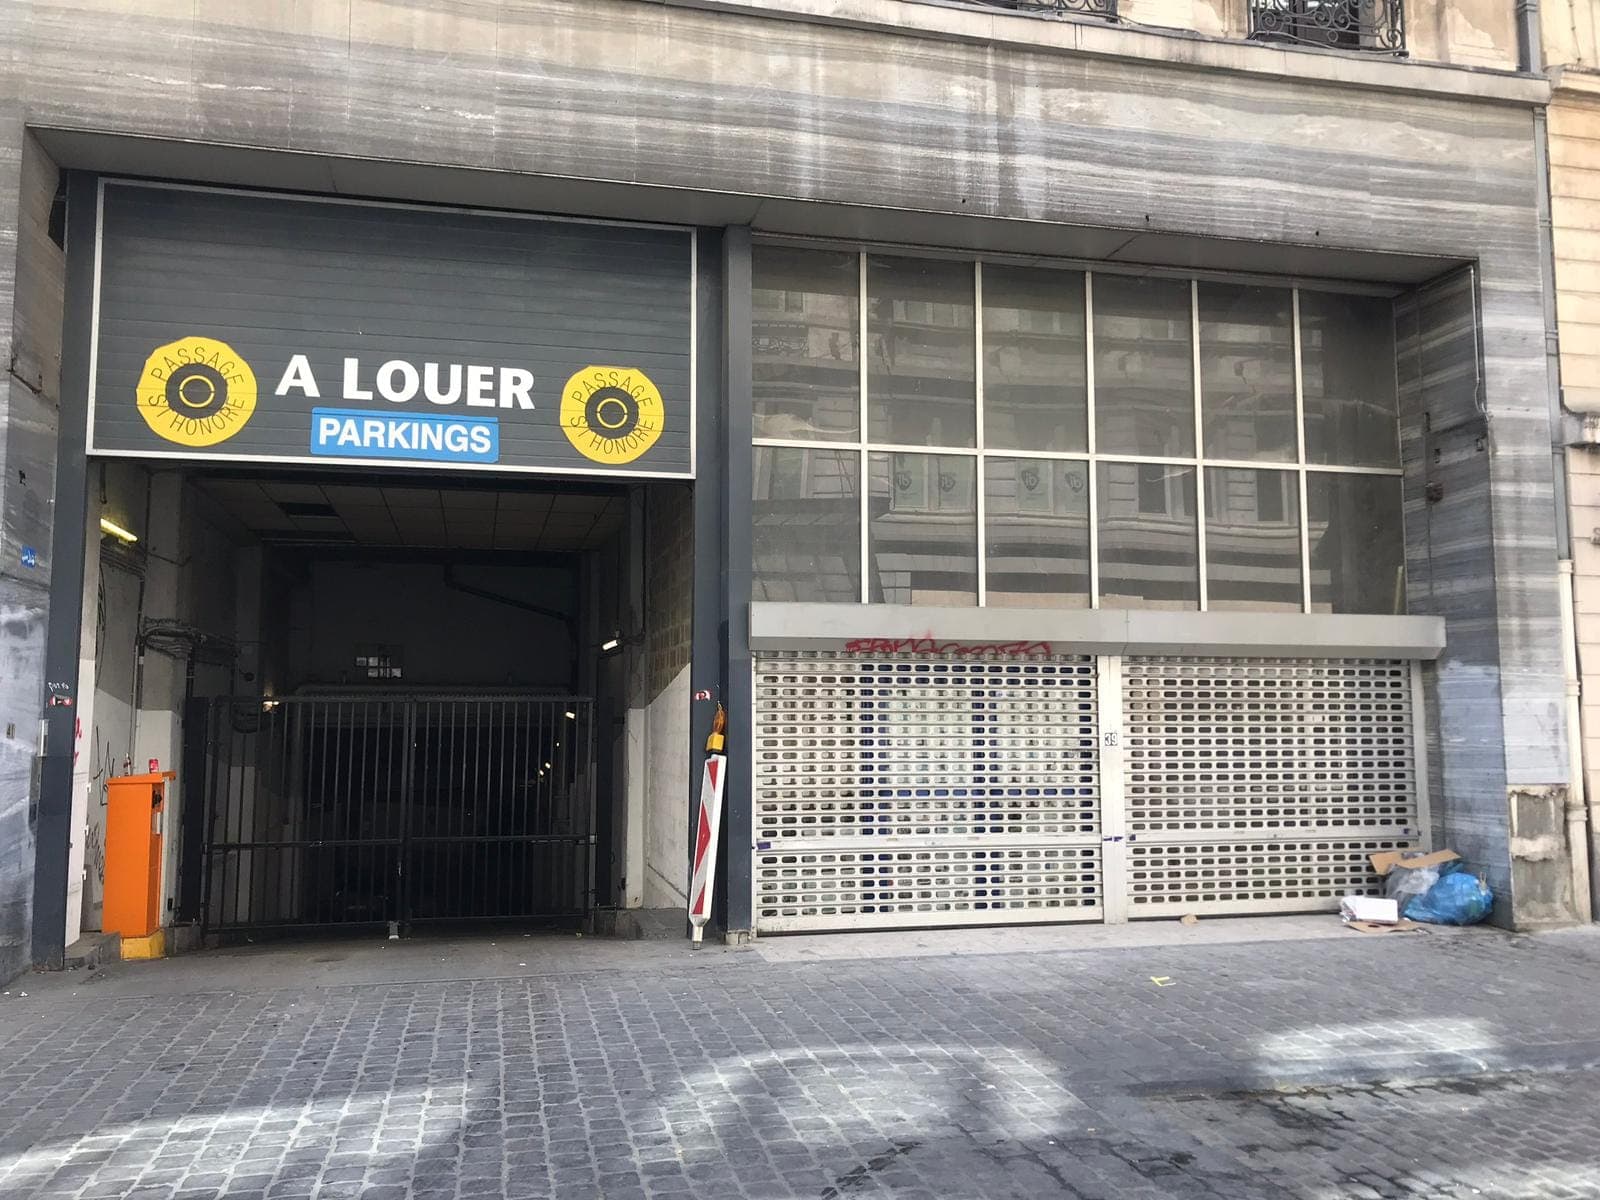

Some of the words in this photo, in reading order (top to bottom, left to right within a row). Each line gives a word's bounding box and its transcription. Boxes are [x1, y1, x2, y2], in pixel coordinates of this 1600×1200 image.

[151, 347, 245, 384] PASSAGE
[274, 353, 321, 398] A
[342, 357, 535, 410] LOUER
[571, 371, 654, 407] PASSAGE
[170, 396, 245, 436] HONORE
[318, 417, 492, 454] PARKINGS
[589, 418, 654, 455] HONORE
